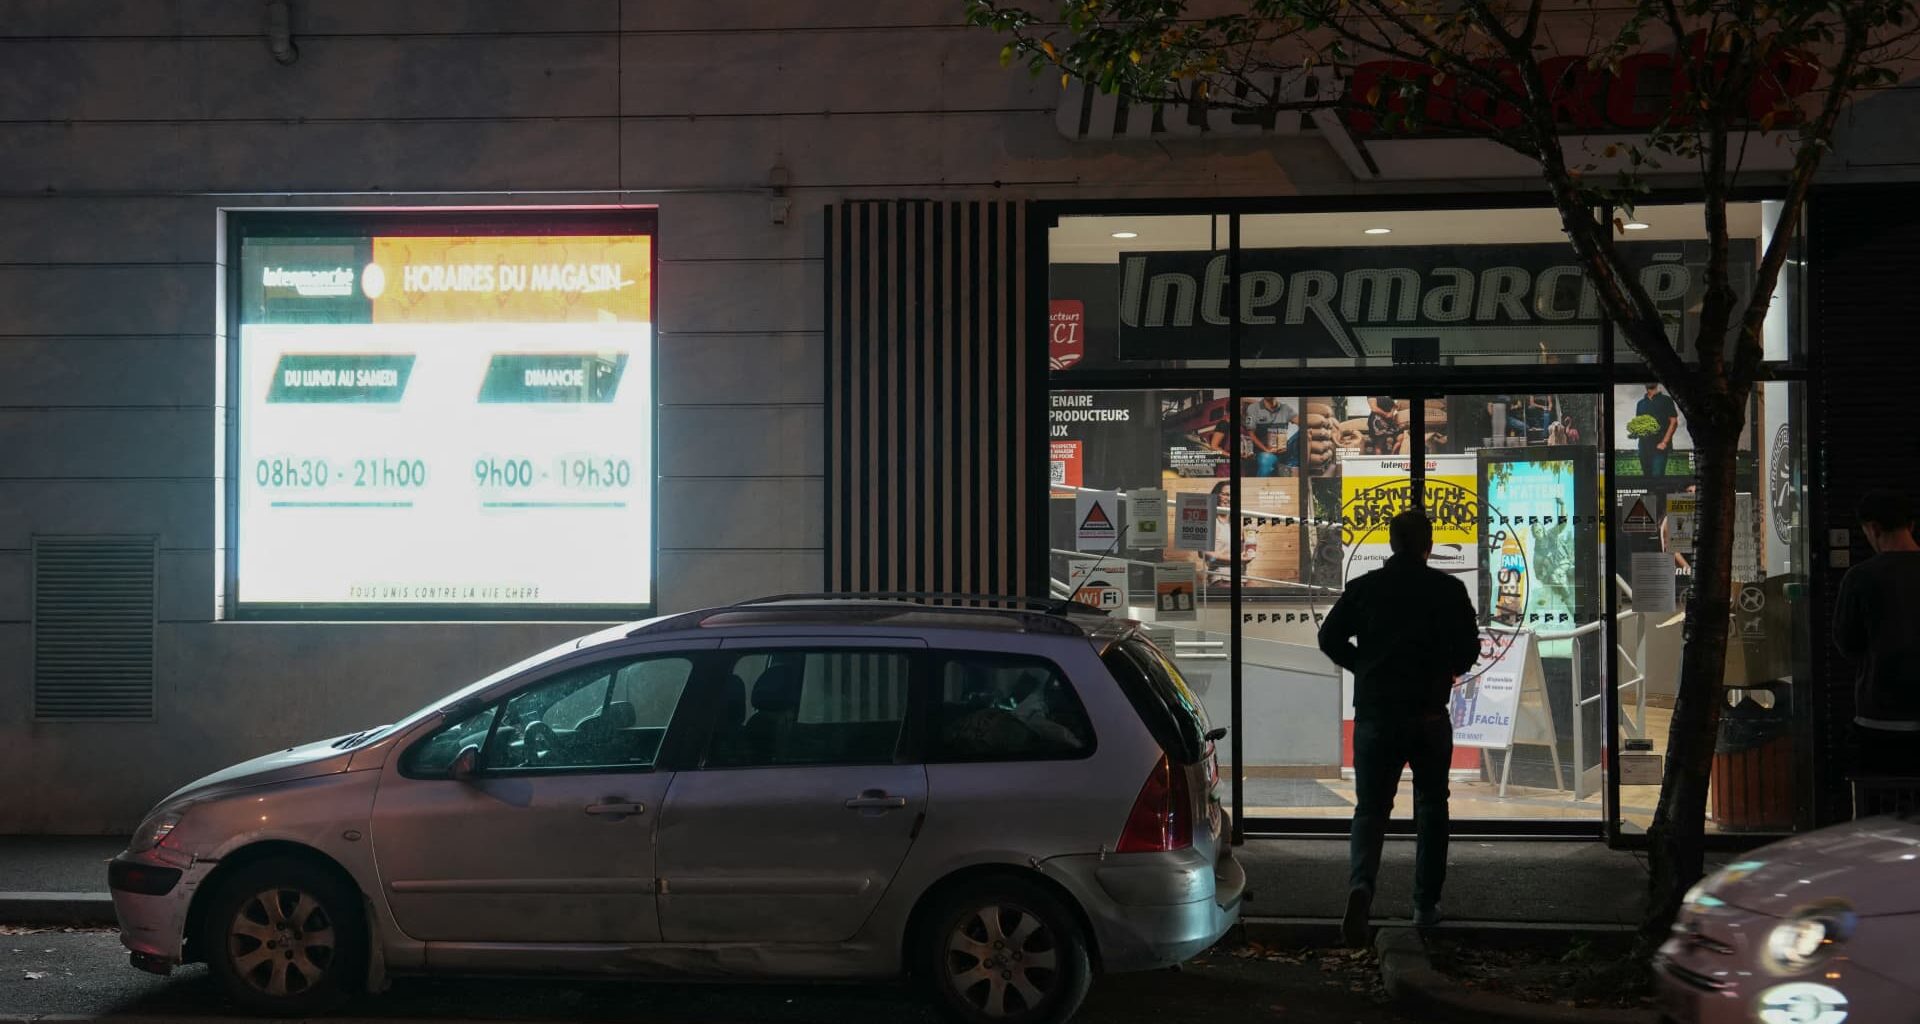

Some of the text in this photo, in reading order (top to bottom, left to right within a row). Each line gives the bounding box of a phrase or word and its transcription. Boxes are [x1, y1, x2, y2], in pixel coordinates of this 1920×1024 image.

[403, 263, 622, 293] HORAIRES DU MAGASIN
[285, 369, 398, 387] DU LUNDI AU SAMEDI
[524, 369, 584, 387] DIMANCHE
[1049, 409, 1130, 422] PRODUCTEURS
[256, 458, 329, 488] 08h30
[353, 458, 426, 488] 21h00
[474, 458, 533, 488] 9h00
[559, 458, 631, 488] 19h30
[349, 586, 377, 598] TOUS
[382, 586, 409, 598] UNIS
[414, 586, 458, 598] CONTRE
[463, 586, 476, 598] LA
[482, 586, 500, 598] VIE
